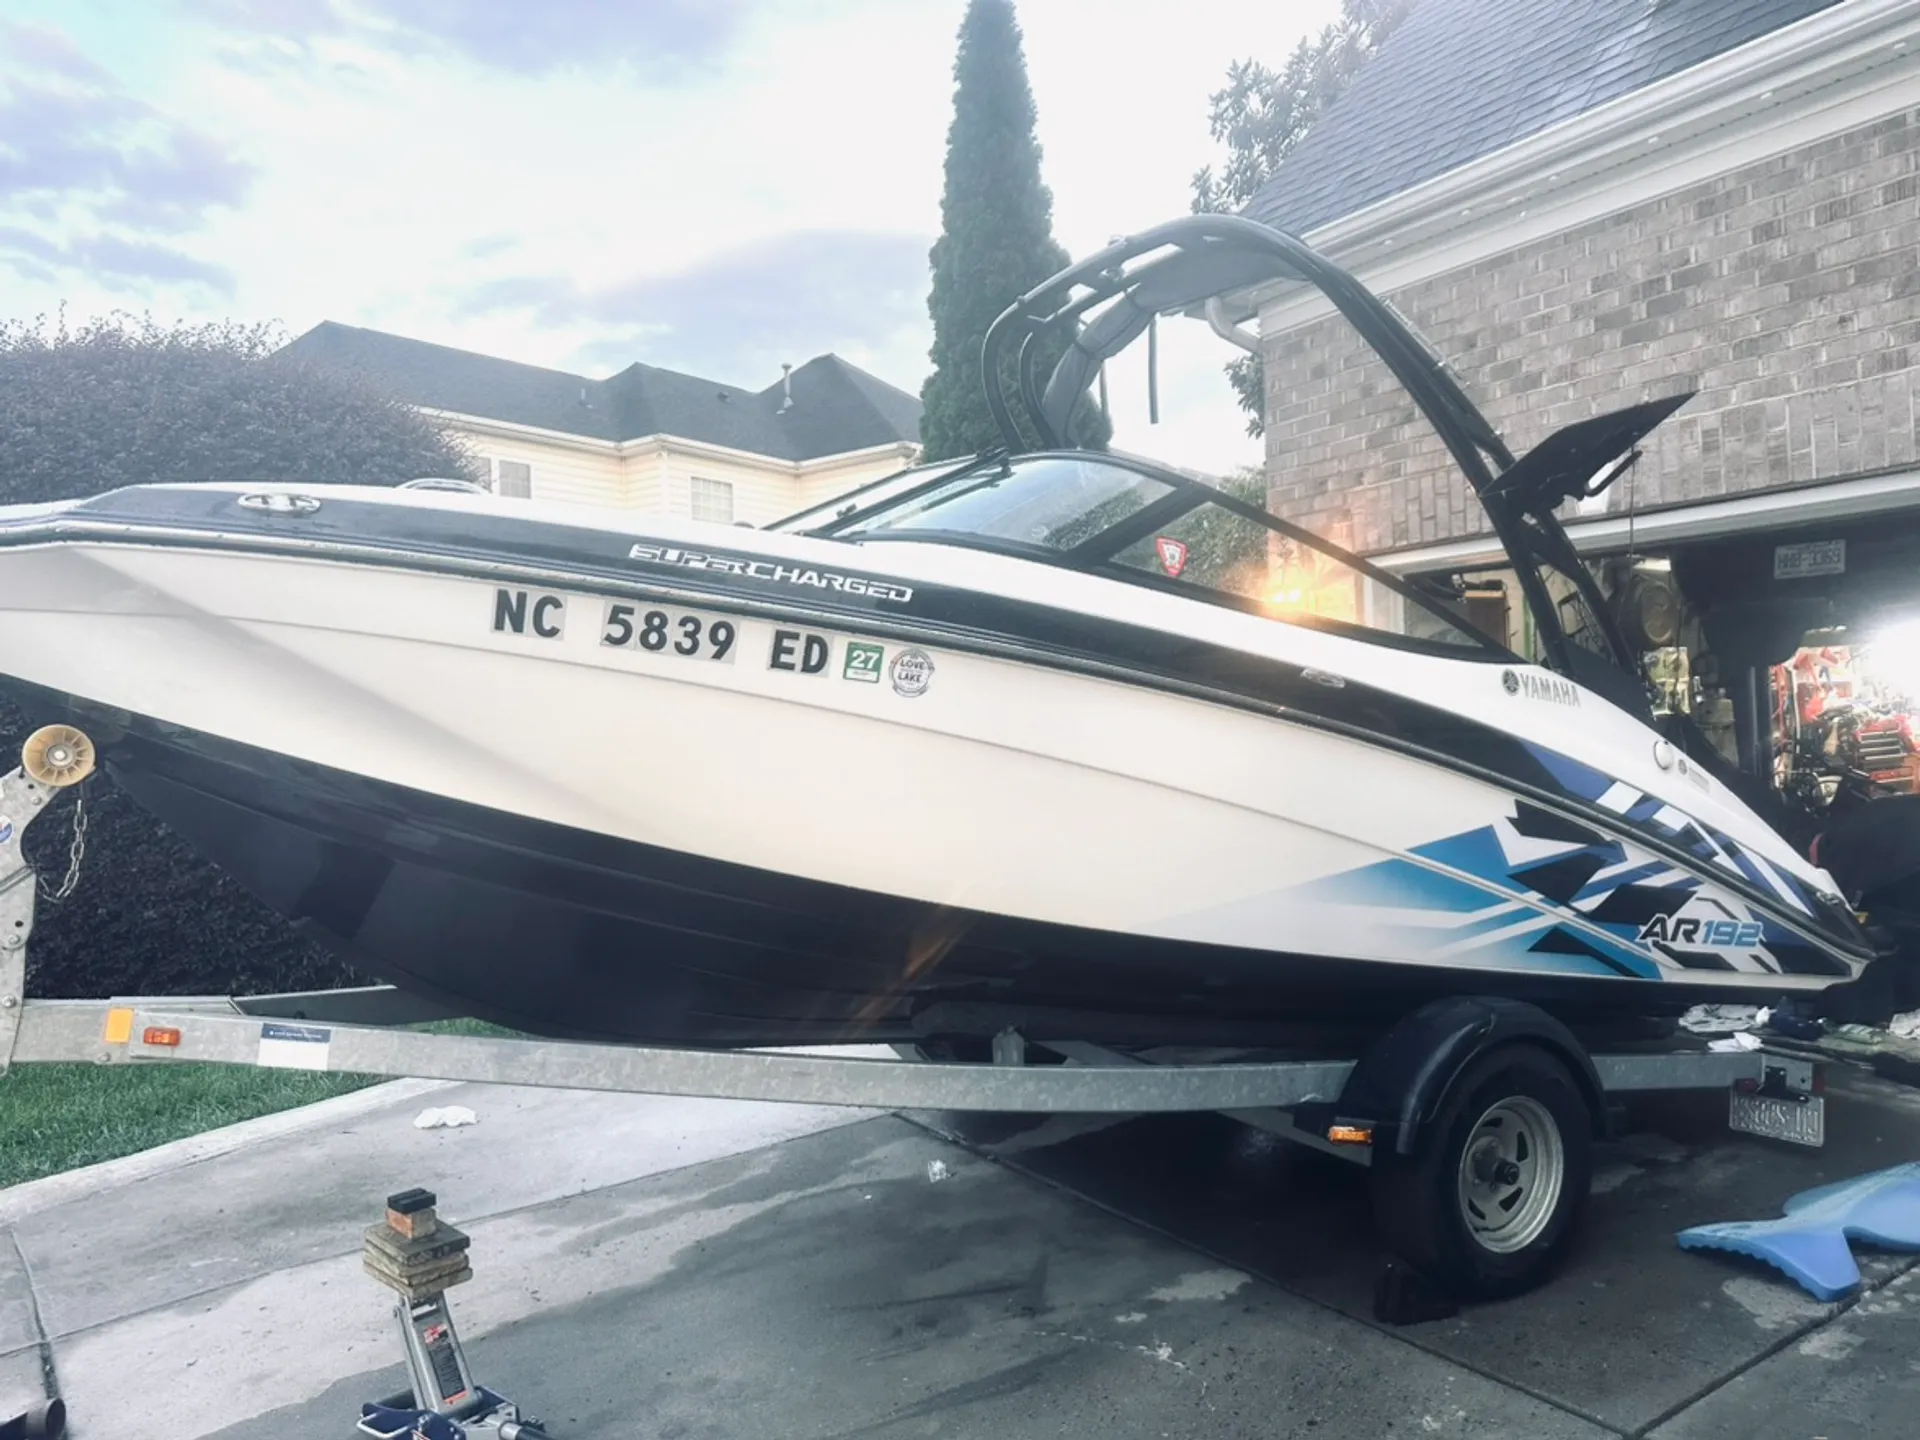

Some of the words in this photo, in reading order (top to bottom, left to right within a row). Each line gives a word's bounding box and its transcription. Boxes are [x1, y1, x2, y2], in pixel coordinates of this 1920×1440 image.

[629, 543, 914, 603] SUPERCHARGED
[493, 588, 564, 639] NC
[604, 604, 736, 661] 5839
[770, 629, 829, 675] ED
[850, 649, 880, 670] 27
[900, 659, 926, 671] LOVE
[898, 671, 922, 684] LAKE
[1520, 672, 1581, 708] YAMAHA
[1639, 915, 1761, 947] AR192
